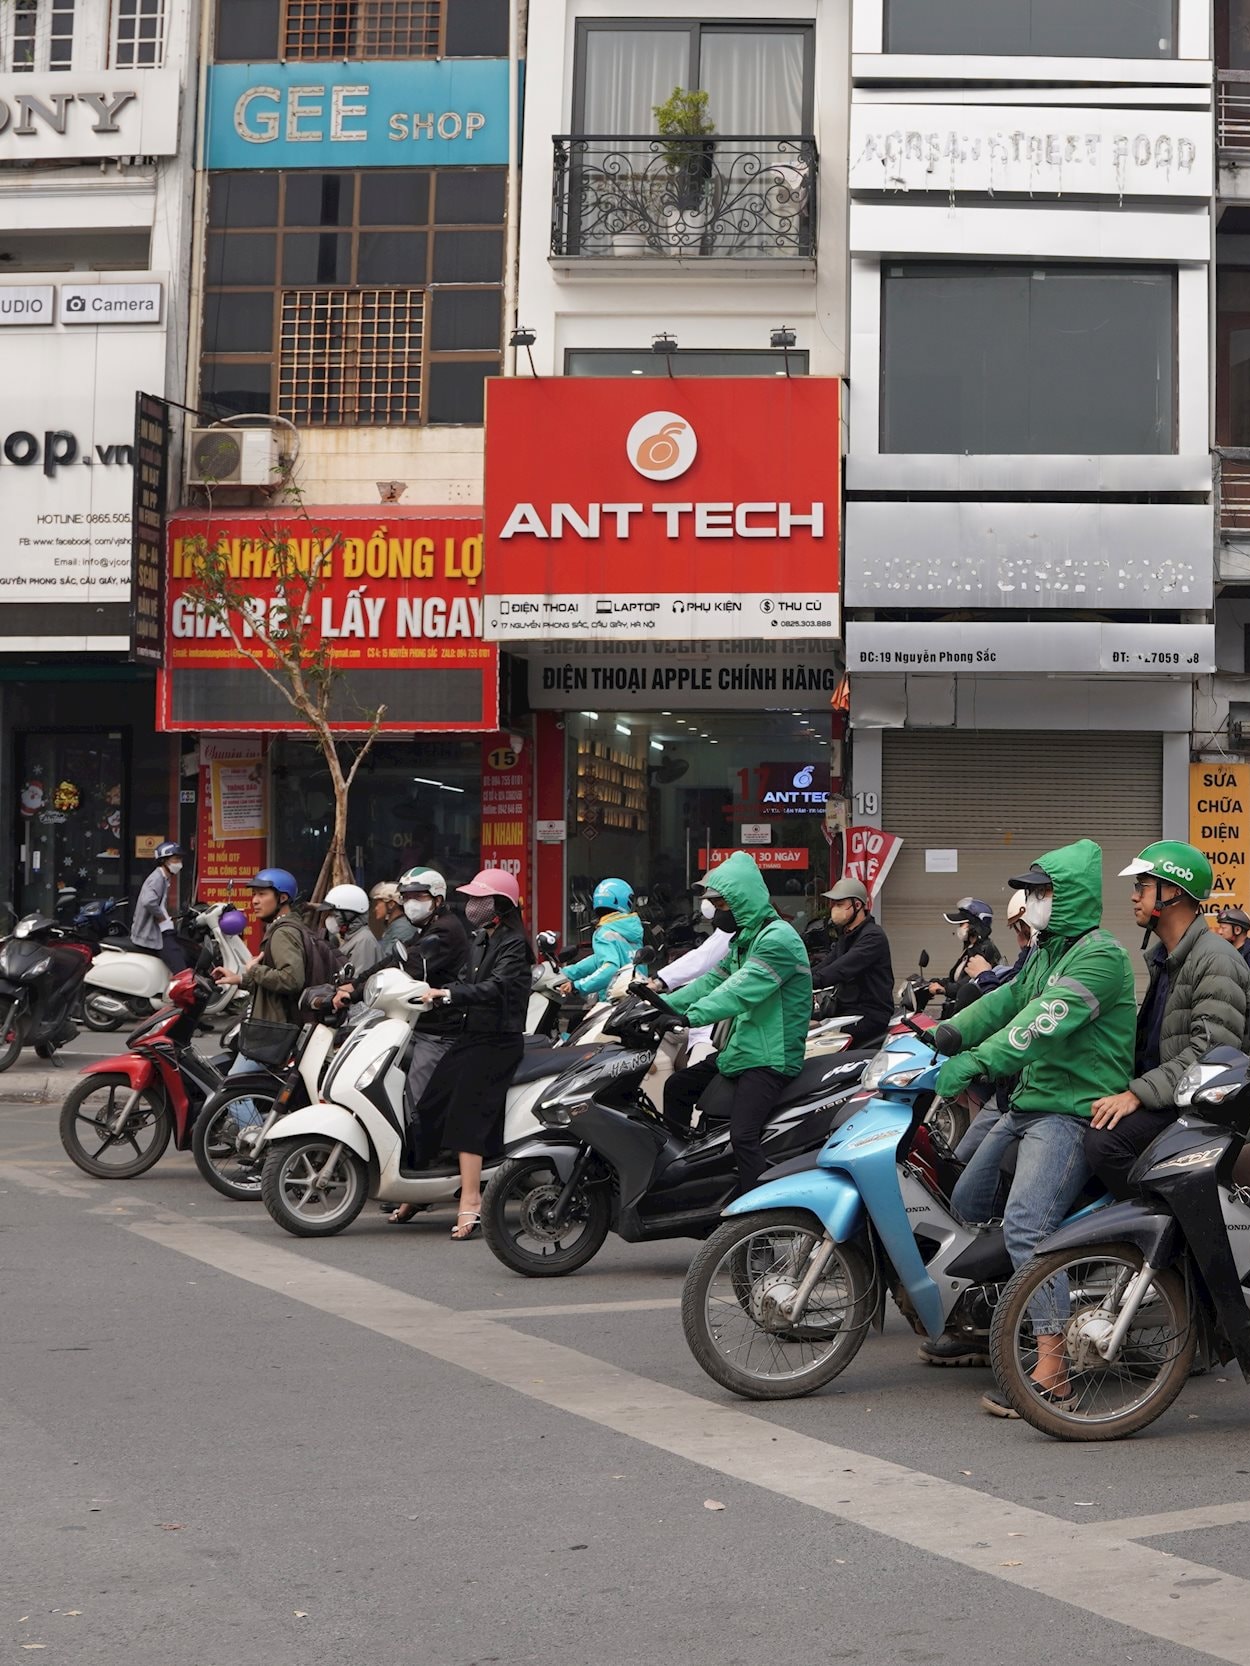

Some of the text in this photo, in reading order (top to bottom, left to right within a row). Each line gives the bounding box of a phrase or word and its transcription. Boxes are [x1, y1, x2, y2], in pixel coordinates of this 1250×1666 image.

[0, 91, 136, 136] NY
[234, 85, 485, 143] GEE SHOP
[91, 296, 154, 312] Camera
[37, 514, 84, 524] HOTLINE:
[499, 502, 824, 539] ANT TECH
[343, 525, 435, 579] ĐỒNG
[29, 577, 57, 585] PHONG
[320, 585, 386, 639] LẤY
[396, 597, 483, 639] NGAY
[512, 601, 579, 614] ĐIỆN THOẠI
[614, 602, 660, 612] LAPTOP
[686, 600, 742, 613] PHỤ KIỆN
[778, 600, 822, 611] THU CŨ
[894, 649, 937, 664] Nguyễn
[939, 652, 973, 665] Phong
[976, 648, 997, 663] Sắc
[1112, 651, 1130, 663] ĐT:
[543, 663, 835, 694] ĐIỆN THOẠI APPLE CHÍNH HÃNG
[491, 751, 516, 766] 15
[1203, 767, 1238, 788] SỬA
[763, 791, 800, 803] ANT
[855, 792, 878, 815] 19
[1197, 796, 1243, 814] CHỮA
[482, 822, 492, 845] IN
[493, 822, 523, 845] NHANH
[1201, 822, 1239, 843] ĐIỆN
[759, 849, 801, 861] 30 NGÀY
[1162, 861, 1194, 882] Grab
[1008, 999, 1070, 1051] Grab
